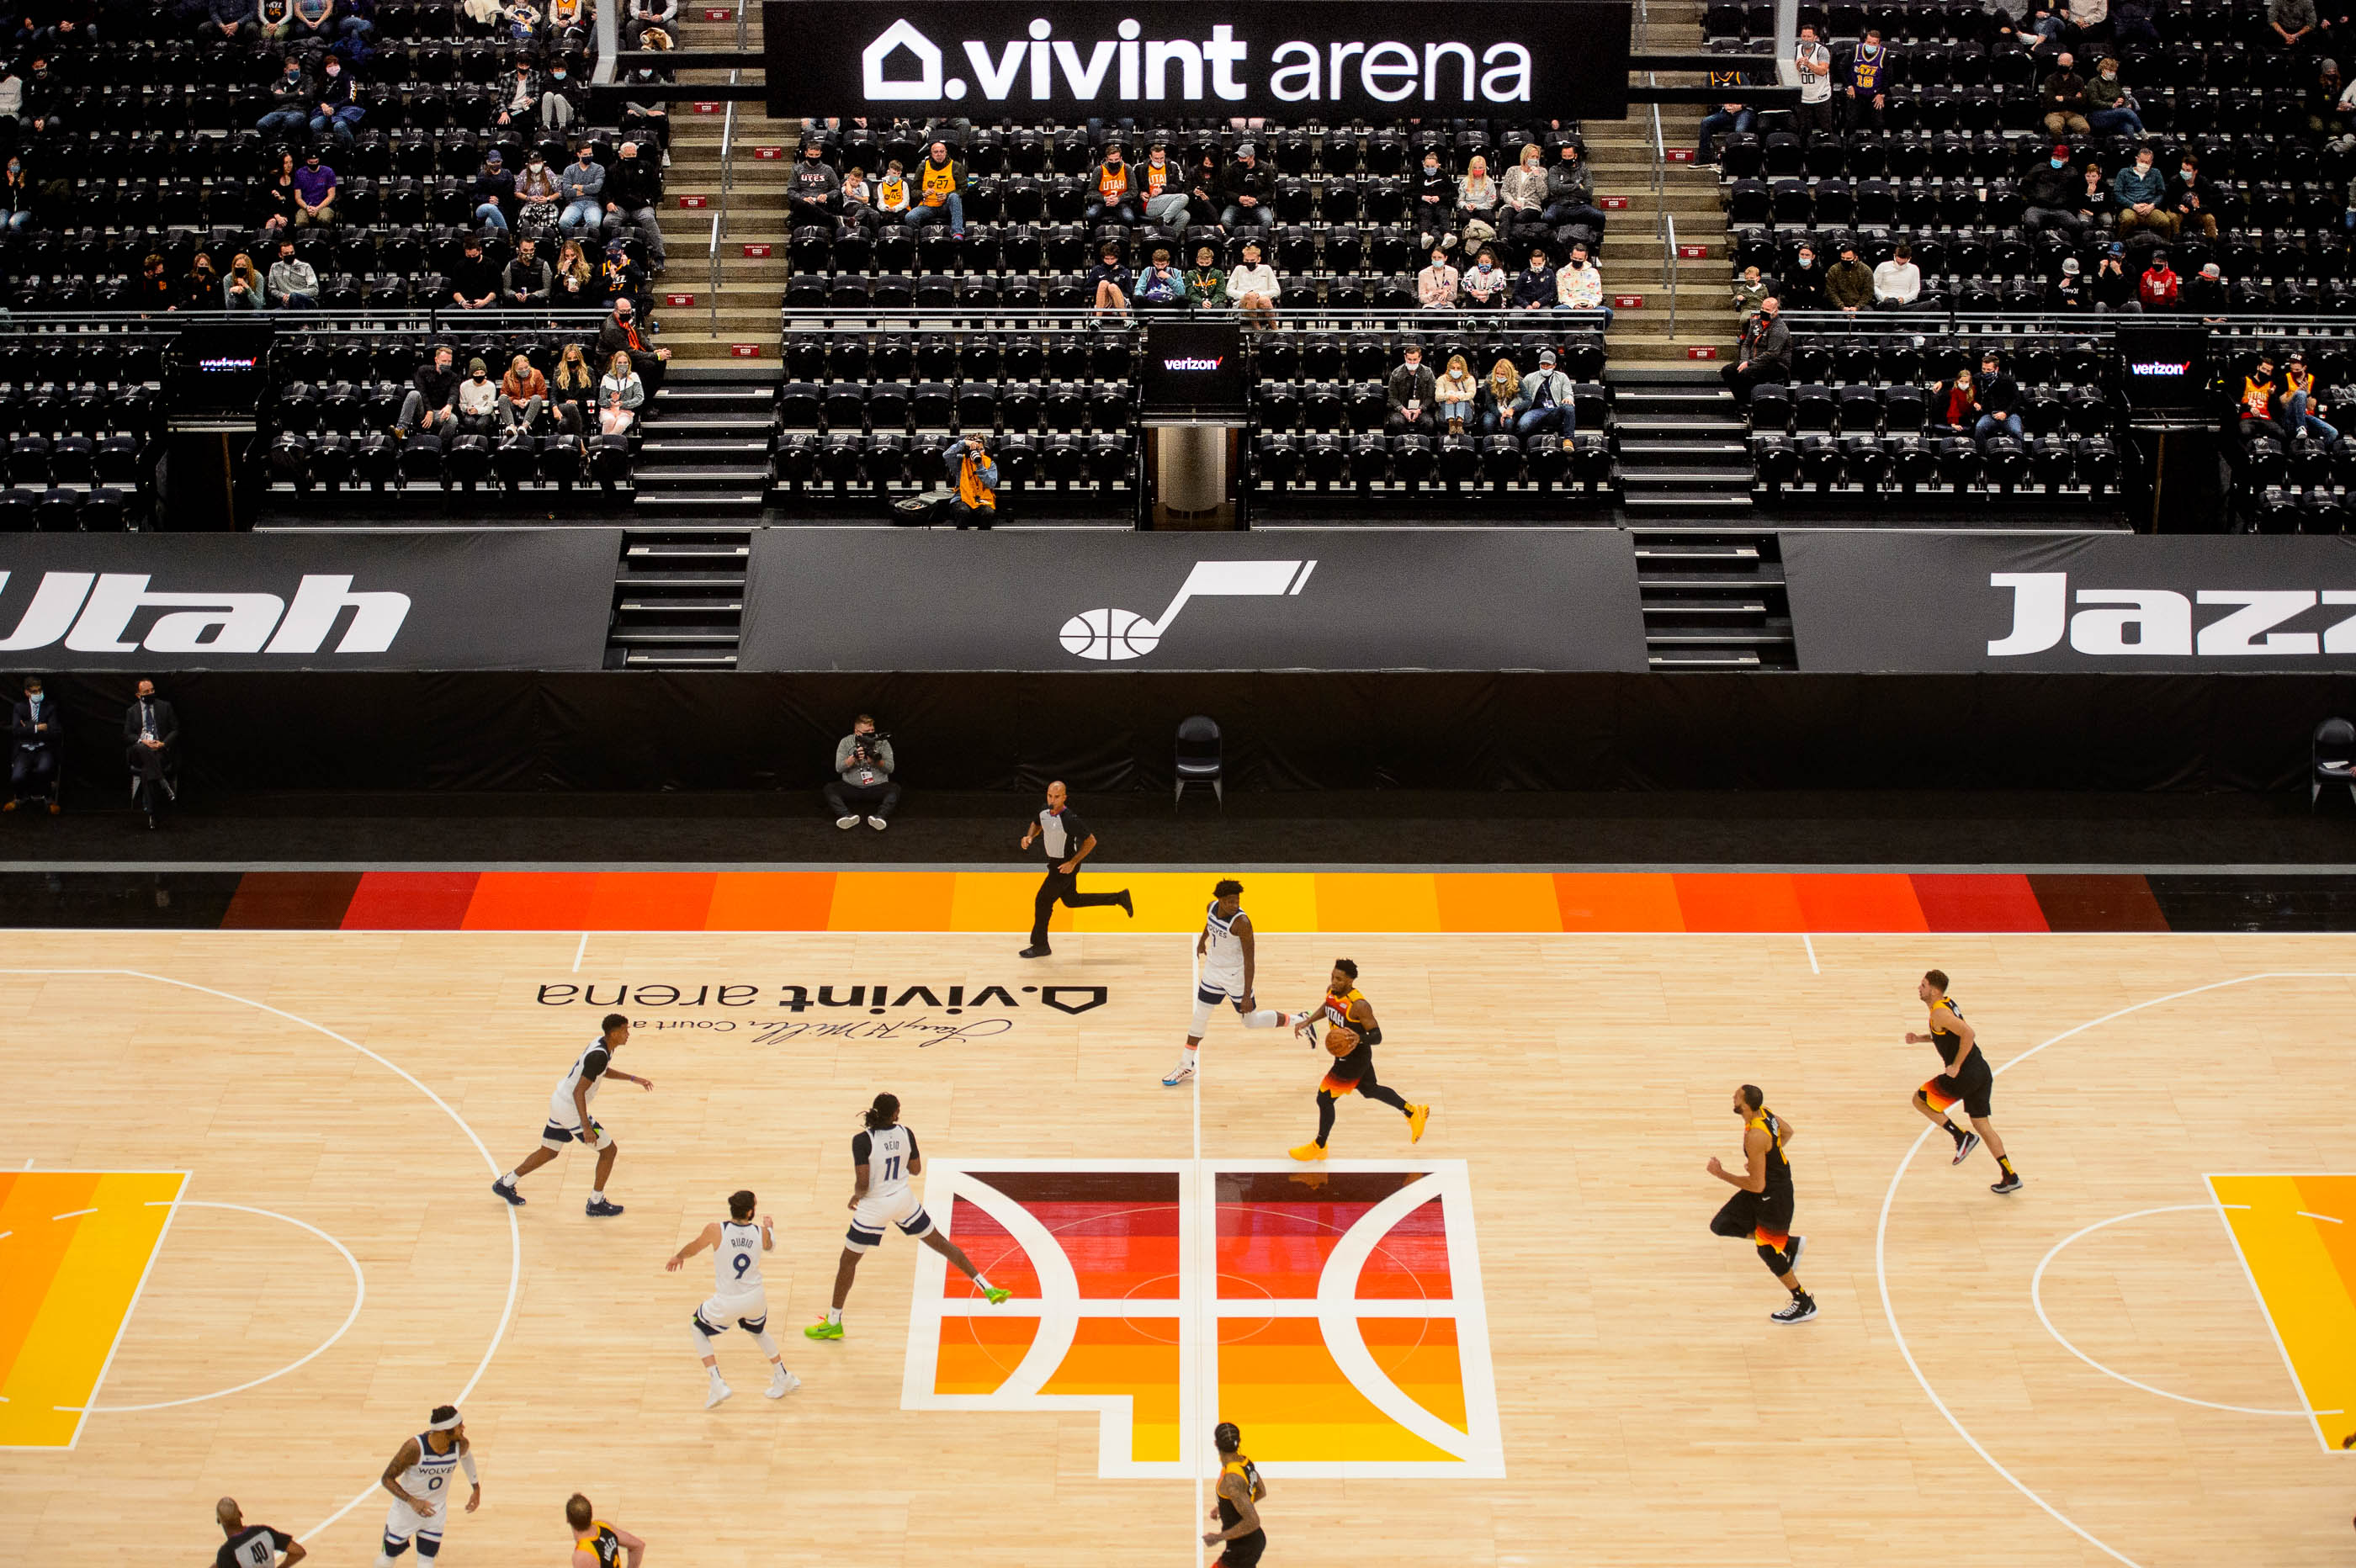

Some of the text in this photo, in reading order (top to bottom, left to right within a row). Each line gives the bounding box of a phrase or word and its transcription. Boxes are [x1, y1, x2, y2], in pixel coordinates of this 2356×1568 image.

[1271, 41, 1531, 102] arena
[1801, 73, 1815, 84] 00
[1856, 75, 1873, 87] 18
[937, 179, 949, 189] 27
[1102, 180, 1125, 191] UTAH
[890, 191, 902, 200] 45
[1164, 357, 1217, 370] verizon
[2131, 362, 2184, 375] verizon
[2247, 391, 2268, 401] UTAH
[2248, 399, 2265, 408] 45
[537, 984, 759, 1007] arena
[632, 1020, 647, 1029] a
[655, 1020, 736, 1032] Court
[749, 1020, 870, 1046] Miller
[884, 1141, 899, 1152] REID
[884, 1155, 901, 1181] 11
[730, 1237, 755, 1249] RUBIO
[733, 1253, 751, 1279] 9
[428, 1476, 443, 1491] 0
[250, 1540, 269, 1565] 40
